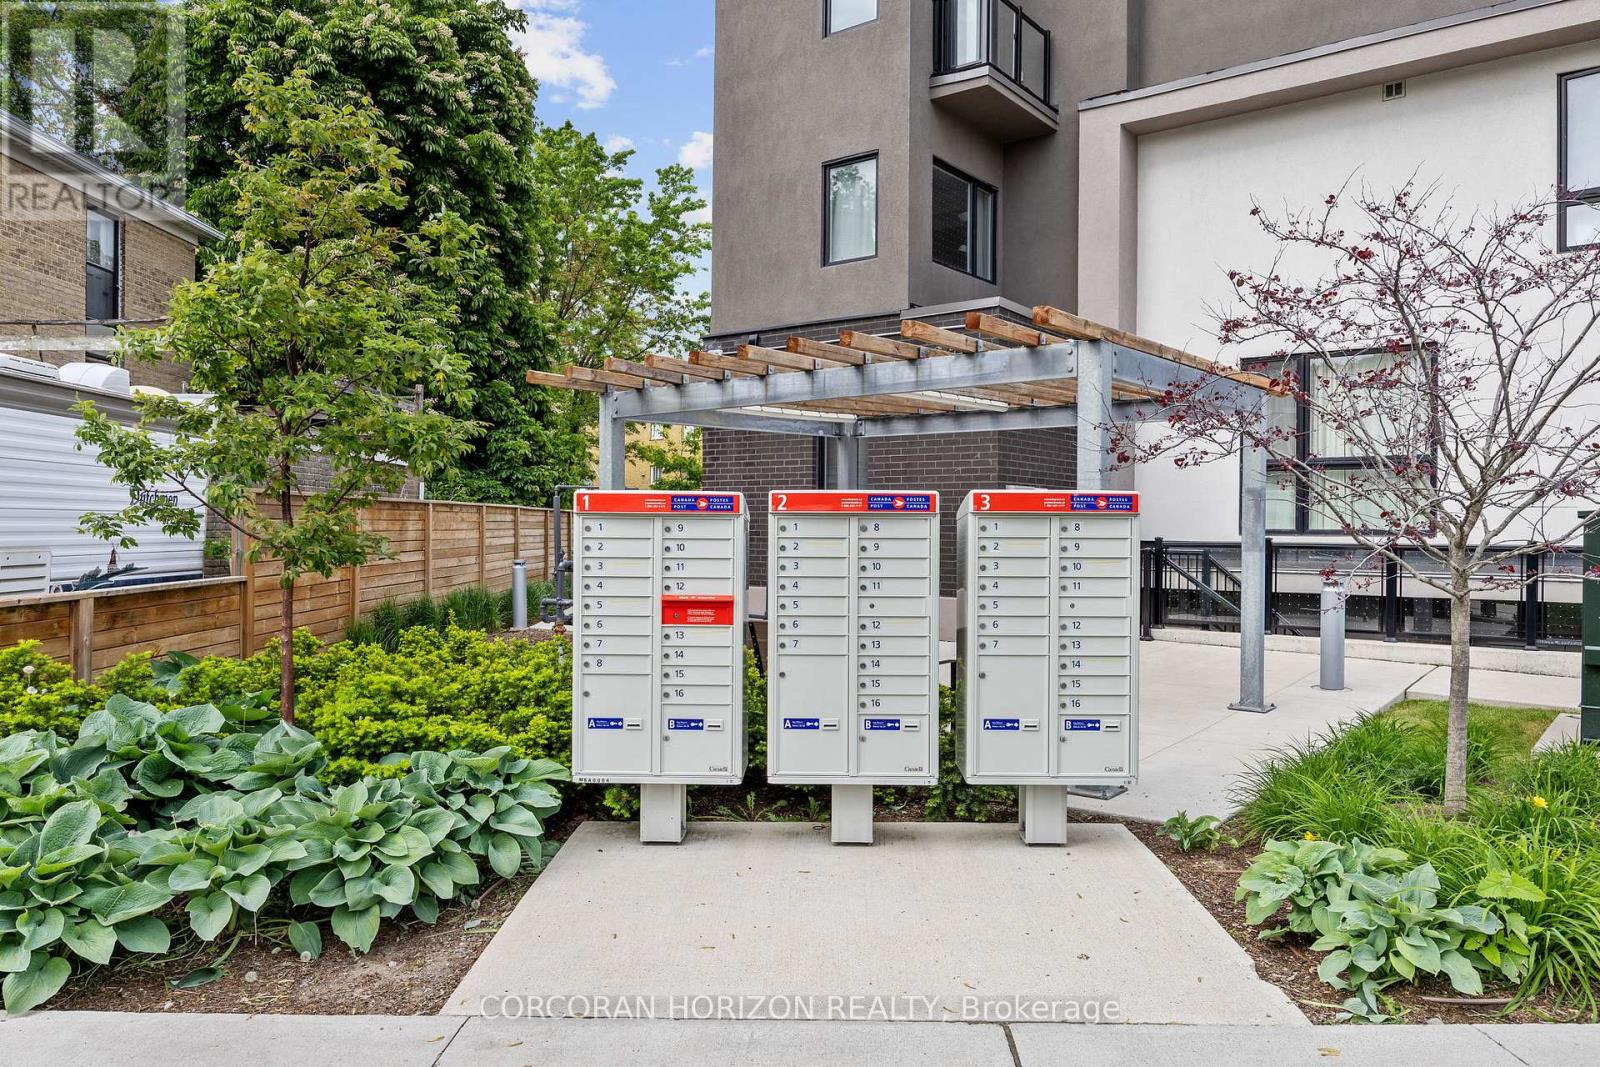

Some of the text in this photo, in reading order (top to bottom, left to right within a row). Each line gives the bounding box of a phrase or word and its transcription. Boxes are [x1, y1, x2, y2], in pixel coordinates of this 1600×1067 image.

[582, 495, 589, 510] 1
[777, 495, 788, 510] 2
[980, 494, 990, 510] 3
[598, 523, 603, 531] 1
[677, 524, 684, 532] 9
[793, 523, 798, 531] 1
[873, 523, 880, 532] 8
[994, 523, 998, 531] 1
[1074, 523, 1081, 531] 8
[597, 543, 604, 551] 2
[676, 543, 685, 552] 10
[793, 542, 799, 551] 2
[873, 543, 880, 551] 9
[993, 542, 999, 551] 2
[1074, 543, 1080, 551] 9
[597, 562, 603, 570] 3
[676, 563, 685, 571] 11
[793, 562, 799, 570] 3
[872, 562, 881, 570] 10
[993, 562, 999, 570] 3
[1073, 562, 1082, 571] 10
[597, 581, 603, 589] 4
[676, 582, 685, 590] 12
[792, 581, 799, 589] 4
[872, 582, 881, 590] 11
[992, 581, 999, 589] 4
[1073, 582, 1081, 590] 11
[597, 601, 603, 609] 5
[792, 601, 799, 609] 5
[992, 601, 999, 609] 5
[596, 620, 603, 629] 6
[792, 620, 799, 629] 6
[872, 621, 881, 629] 12
[992, 620, 999, 629] 6
[1072, 621, 1081, 629] 12
[675, 631, 685, 639] 13
[596, 639, 603, 648] 7
[792, 640, 799, 648] 7
[871, 640, 881, 649] 13
[992, 640, 999, 648] 7
[1071, 640, 1081, 649] 13
[675, 651, 684, 659] 14
[596, 659, 603, 667] 8
[871, 660, 880, 668] 14
[1071, 660, 1081, 668] 14
[675, 670, 684, 678] 15
[871, 679, 880, 687] 15
[1071, 679, 1081, 688] 15
[675, 689, 684, 697] 16
[871, 699, 880, 707] 16
[1071, 699, 1081, 708] 16
[588, 719, 596, 728] A
[669, 720, 675, 728] B
[784, 720, 792, 728] A
[865, 721, 871, 729] B
[984, 720, 991, 729] A
[1066, 721, 1072, 729] B
